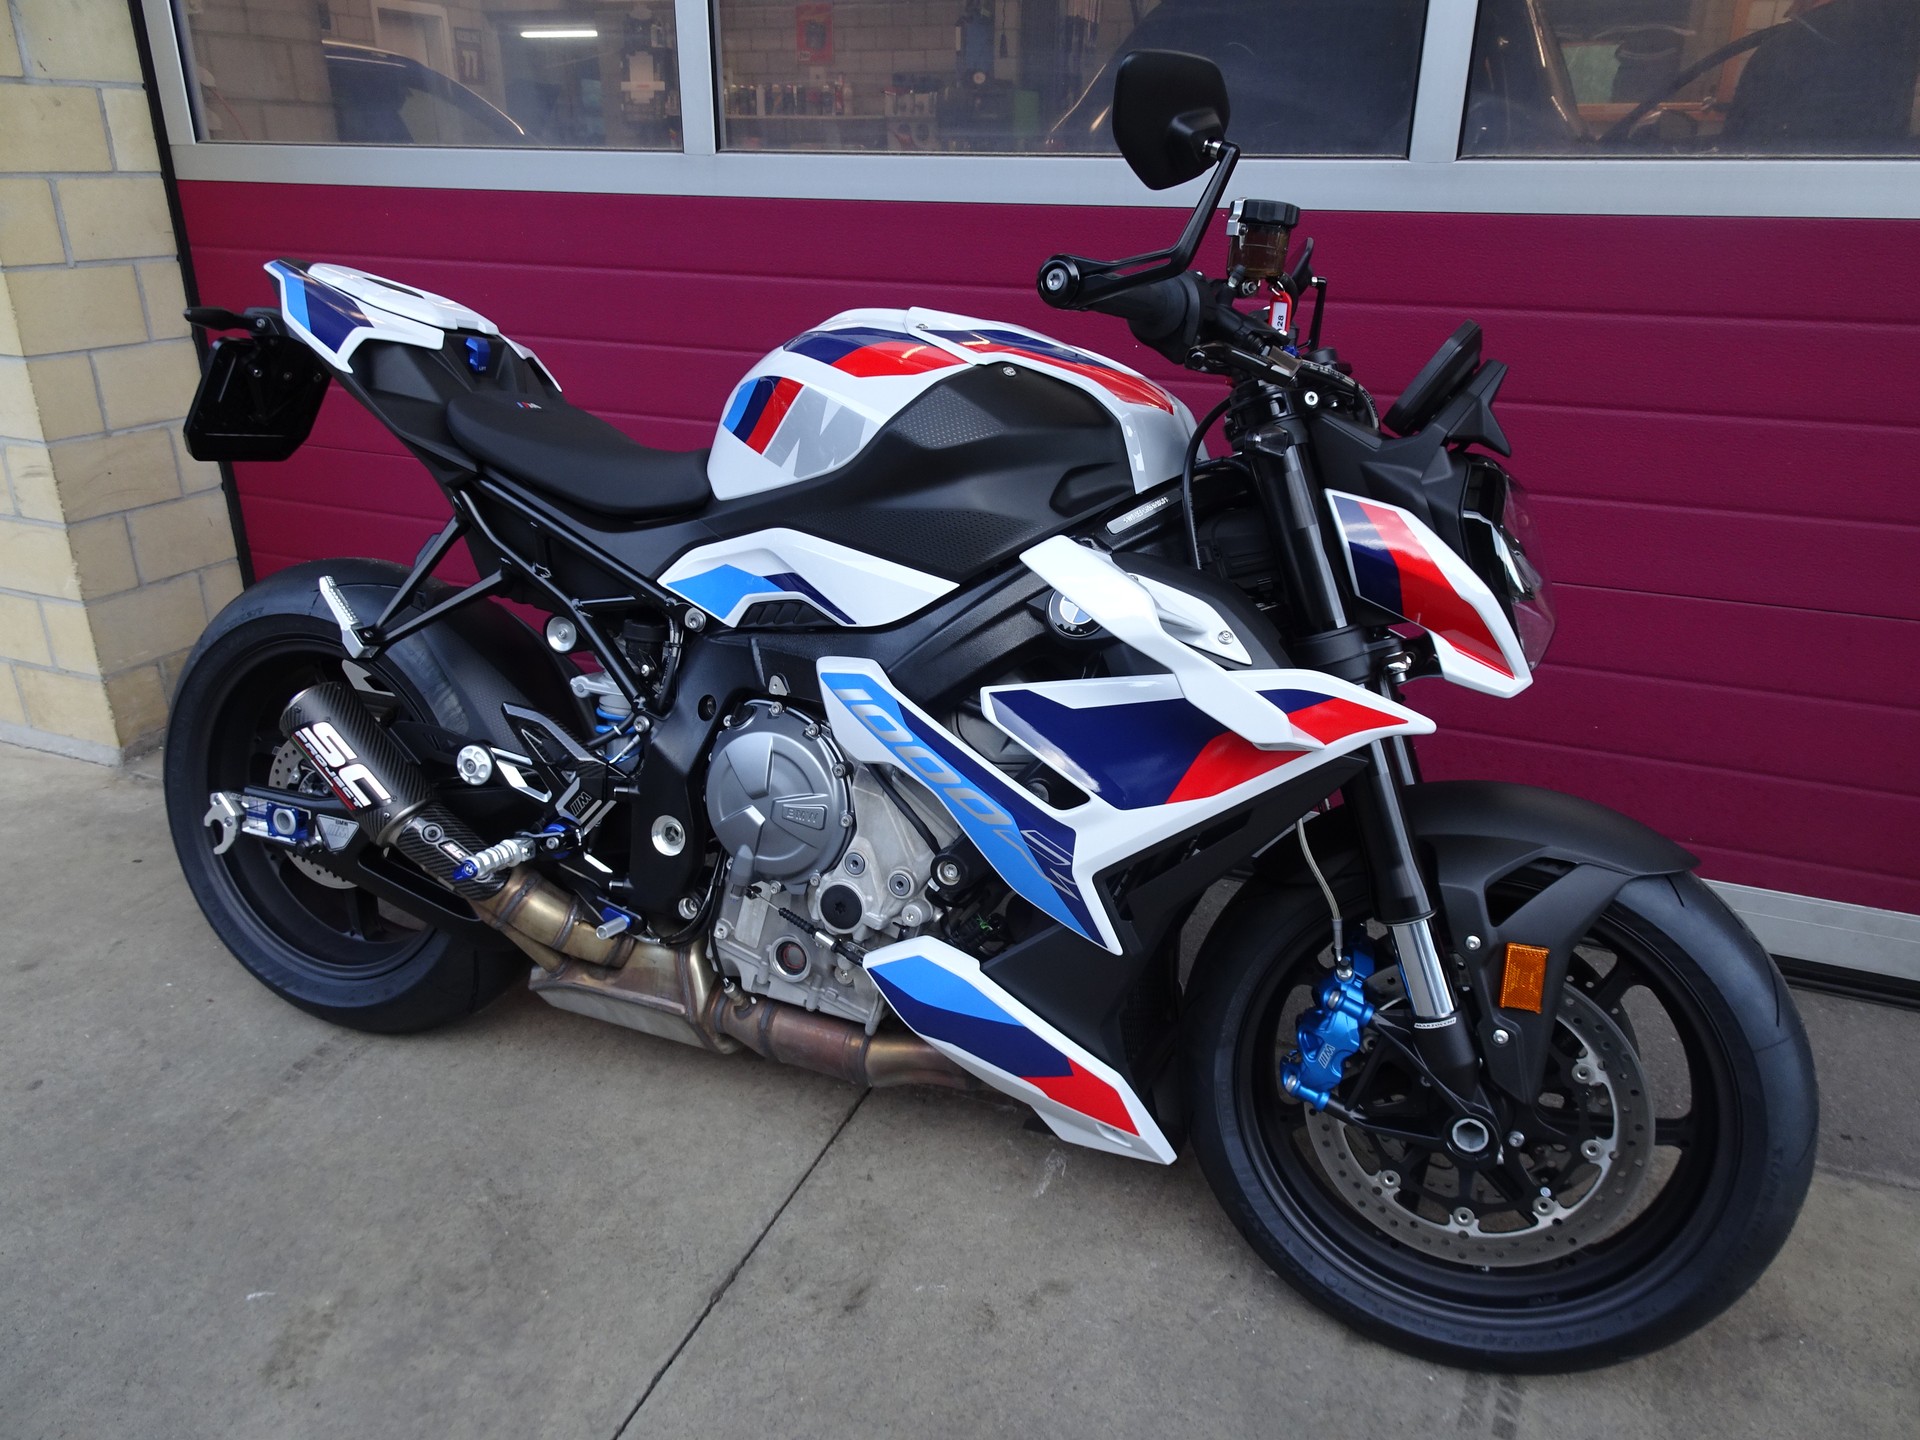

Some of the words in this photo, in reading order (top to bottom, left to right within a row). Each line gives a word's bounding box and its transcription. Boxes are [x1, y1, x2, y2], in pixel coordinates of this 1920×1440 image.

[294, 730, 364, 809] PROJECT
[300, 721, 392, 807] SC
[786, 808, 819, 823] BMW
